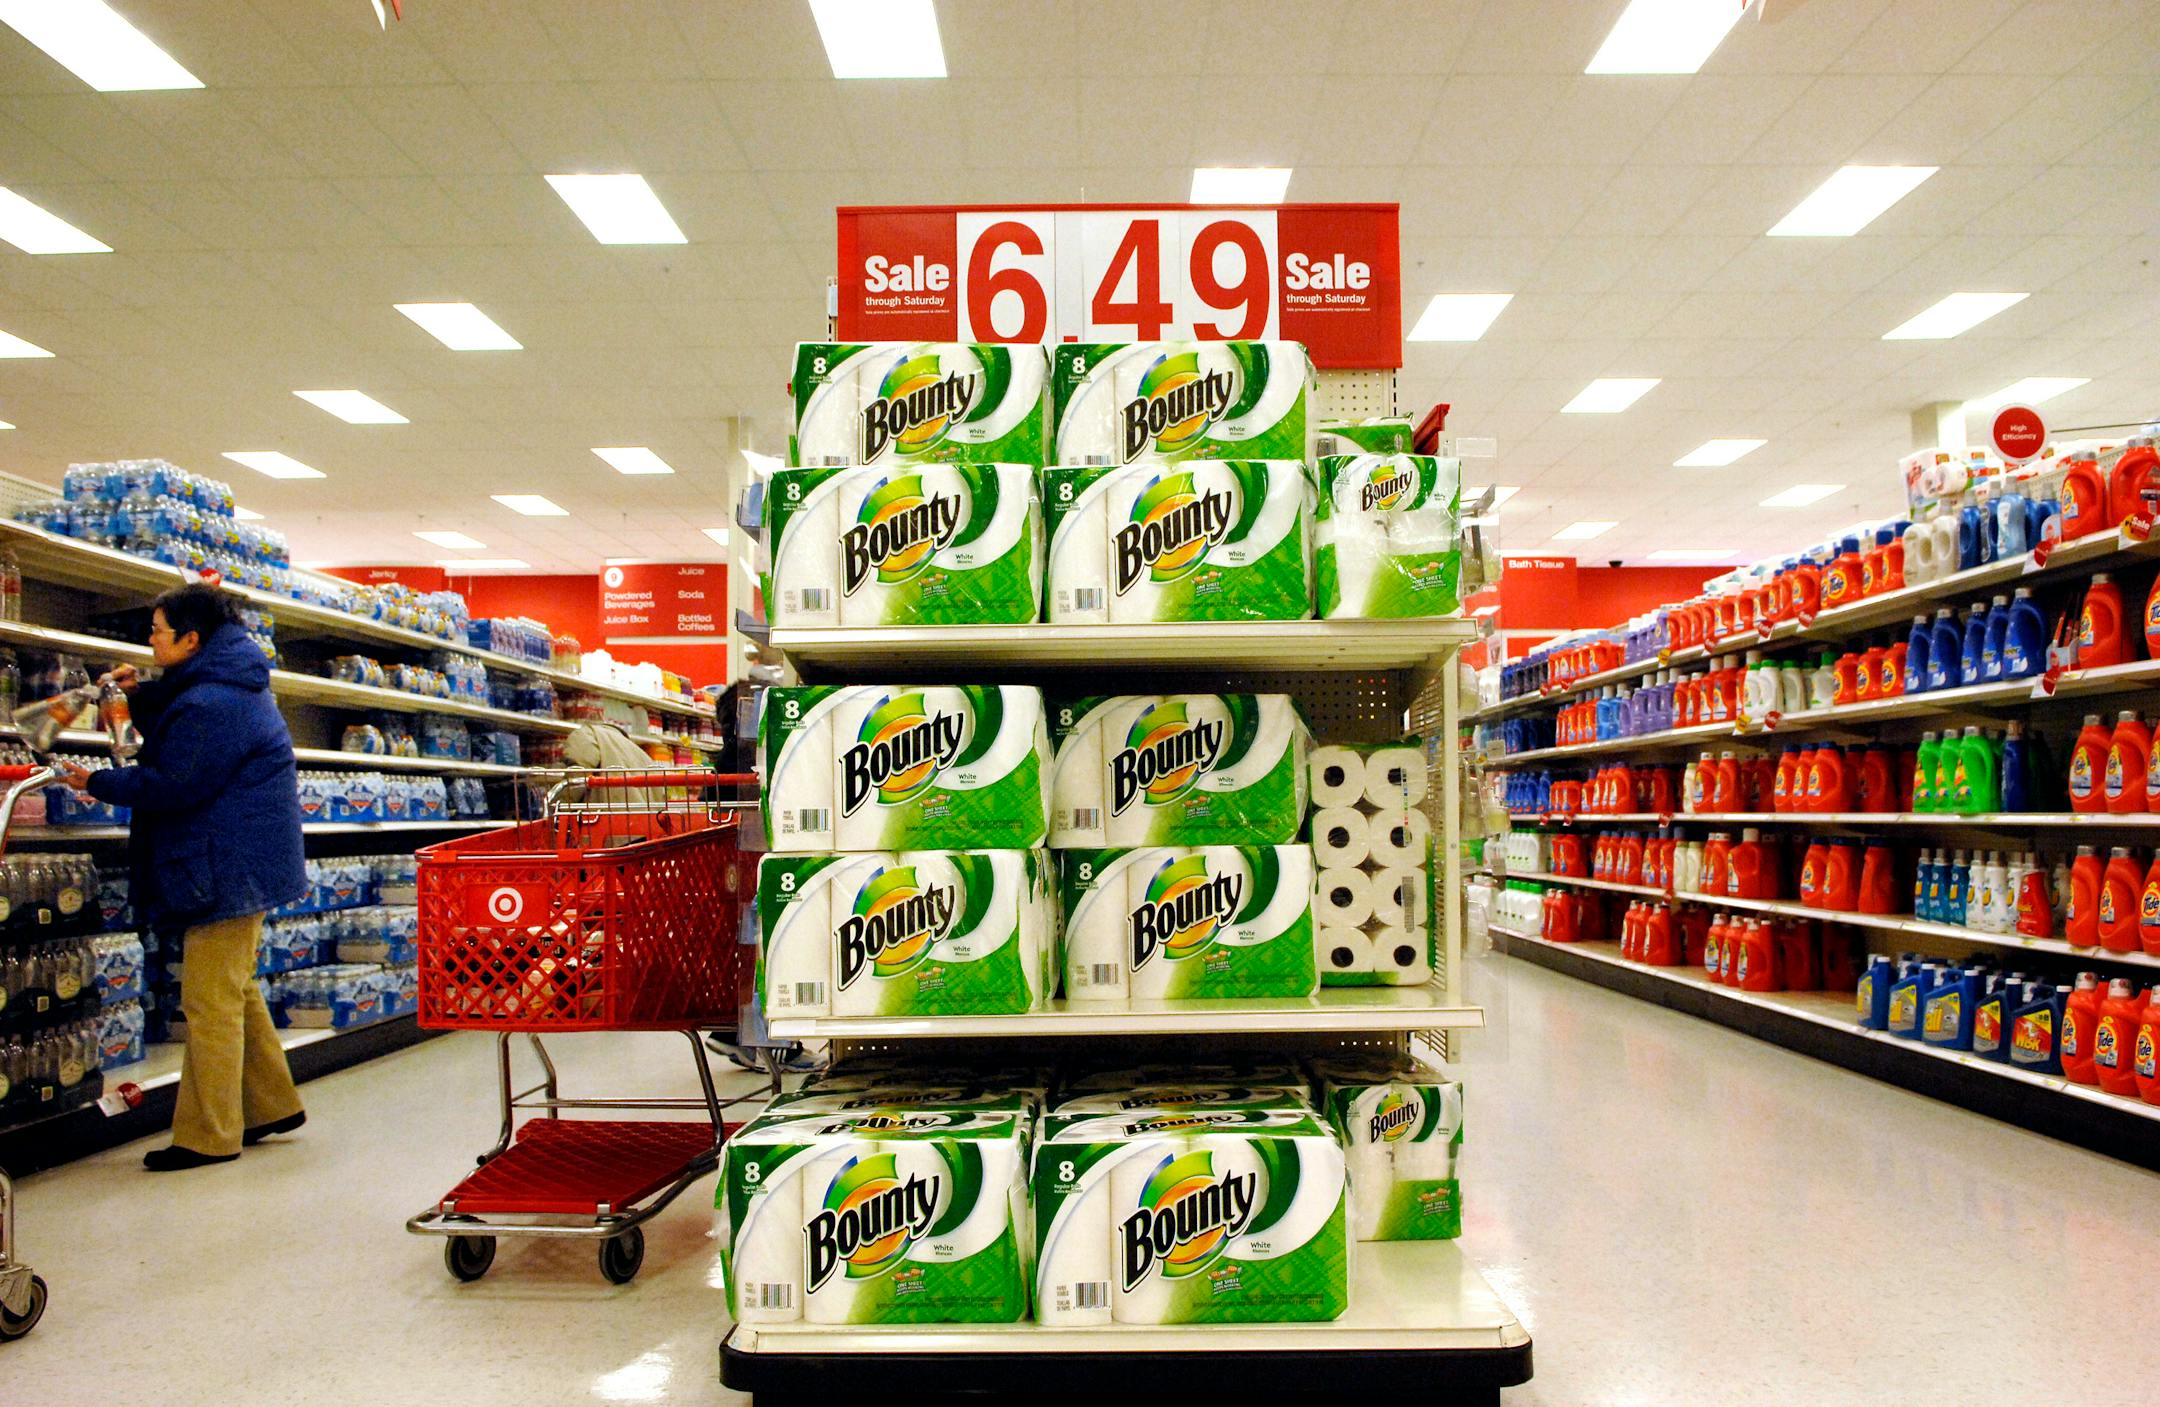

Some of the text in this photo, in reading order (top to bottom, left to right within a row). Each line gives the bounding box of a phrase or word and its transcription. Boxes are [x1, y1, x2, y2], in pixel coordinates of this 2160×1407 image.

[865, 255, 950, 293] Sale
[966, 219, 1270, 343] 6.49
[1286, 253, 1371, 290] Sale
[866, 296, 946, 308] through Saturday
[1286, 294, 1367, 305] through Saturday
[813, 357, 826, 374] 8
[1072, 356, 1085, 374] 8
[862, 369, 975, 464] Bounty
[1121, 368, 1233, 464] Bounty
[2002, 432, 2038, 442] Efficiency
[2010, 424, 2028, 434] High
[786, 482, 800, 501] 8
[1059, 482, 1073, 501] 8
[1361, 471, 1413, 512] Bounty
[2132, 516, 2151, 530] Sale
[839, 491, 961, 596] Bounty
[1113, 488, 1232, 595] Bounty
[1509, 560, 1564, 568] Bath Tissue
[604, 591, 652, 600] Powdered
[678, 590, 704, 599] Soda
[604, 601, 655, 609] Beverages
[604, 615, 649, 624] Juice Box
[678, 614, 712, 622] Bottled
[678, 623, 715, 631] Coffees
[785, 700, 800, 719] 8
[1059, 709, 1073, 726] 8
[840, 710, 965, 817] Bounty
[1109, 718, 1224, 817] Bounty
[1079, 862, 1093, 881] 8
[780, 872, 796, 892] 8
[1128, 871, 1243, 972] Bounty
[836, 882, 955, 991] Bounty
[1368, 1101, 1419, 1144] Bounty
[744, 1161, 761, 1183] 8
[1058, 1160, 1075, 1182] 8
[803, 1171, 940, 1294] Bounty
[1119, 1168, 1257, 1293] Bounty
